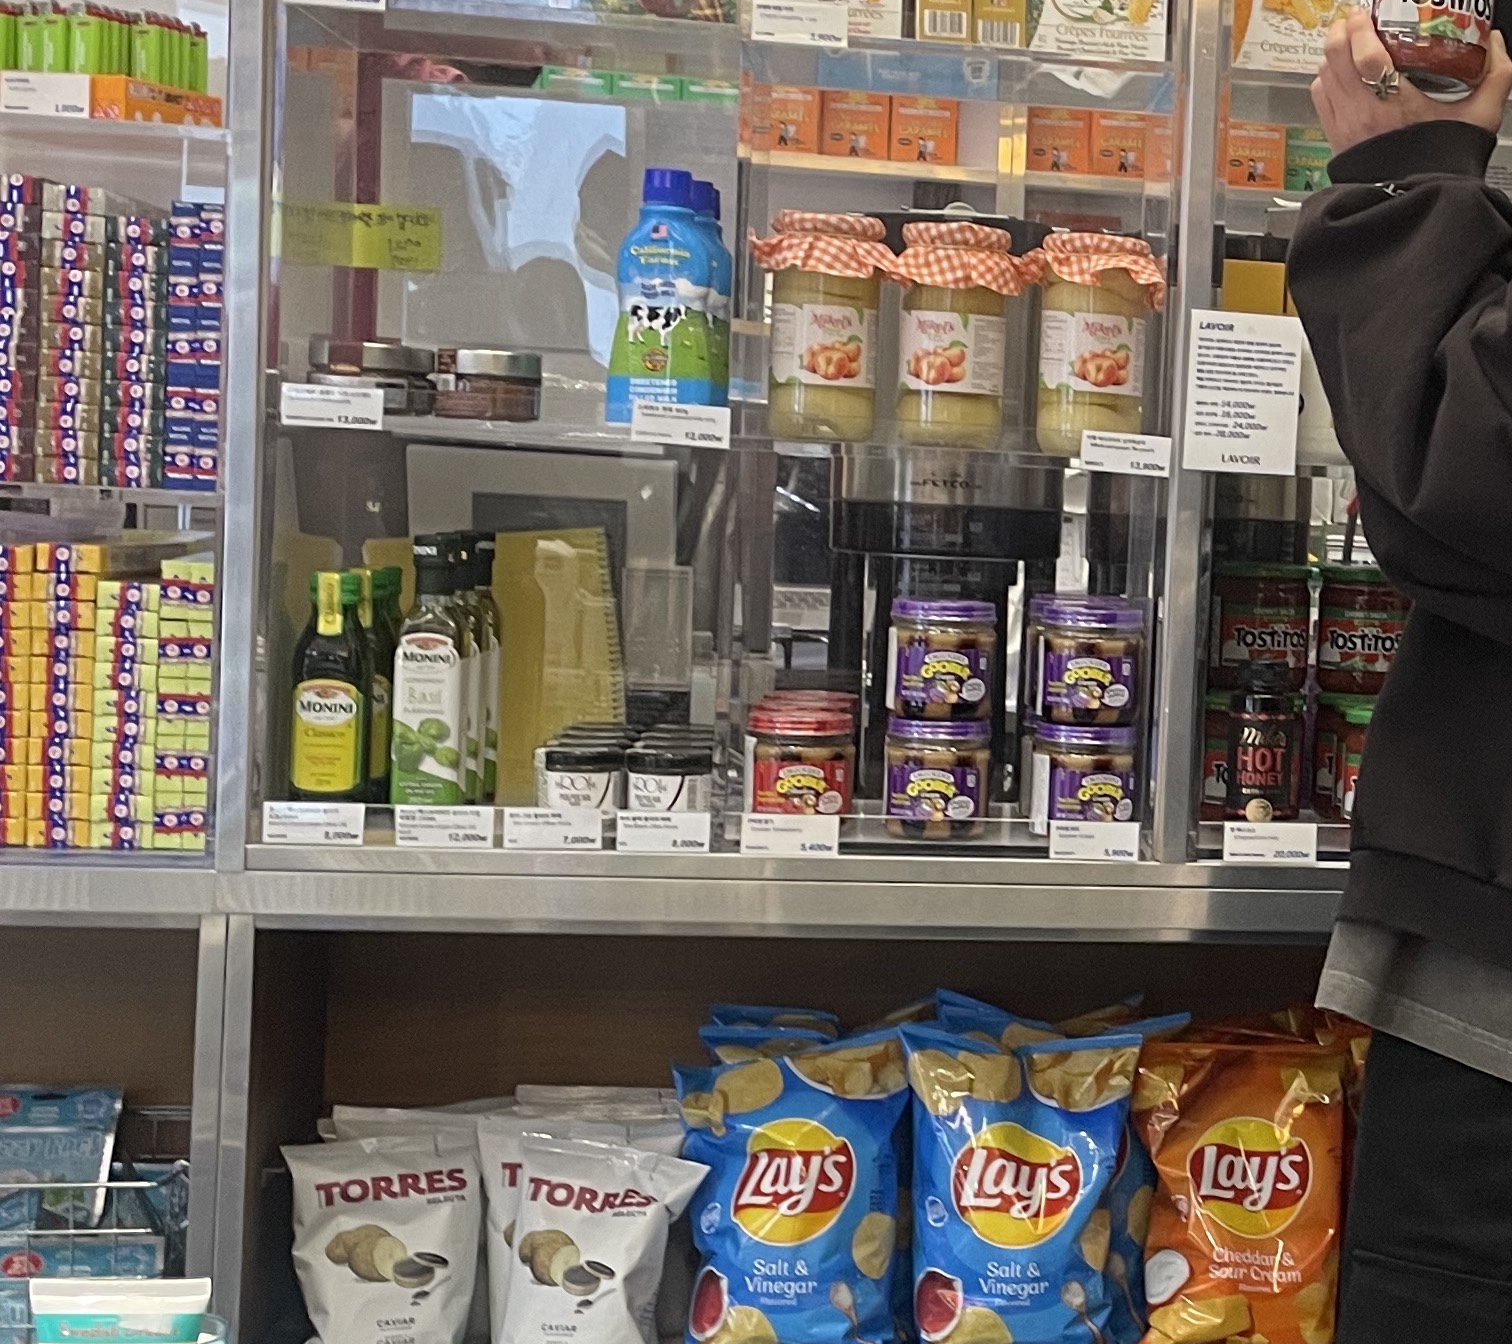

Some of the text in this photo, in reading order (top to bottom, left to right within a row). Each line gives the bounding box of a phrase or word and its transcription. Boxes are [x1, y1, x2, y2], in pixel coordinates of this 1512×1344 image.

[1199, 321, 1235, 332] LAVOIR
[1221, 454, 1261, 465] LAVOIR
[403, 651, 450, 664] MONINI
[299, 701, 354, 715] MONINI
[1237, 747, 1286, 771] HOT
[1236, 771, 1284, 788] HONEY
[315, 1167, 467, 1208] TORRES
[732, 1145, 850, 1217] Lay's
[959, 1149, 1073, 1220] Lay's
[1199, 1144, 1303, 1212] Lay's
[527, 1176, 659, 1215] TORRES
[1211, 1246, 1295, 1266] Cheddar &
[752, 1258, 809, 1278] Salt &
[986, 1260, 1041, 1280] Salt &
[1207, 1263, 1303, 1285] Sour Cream
[745, 1275, 818, 1298] Vinegar
[978, 1277, 1049, 1299] Vinegar
[376, 1317, 416, 1330] CAVIAR
